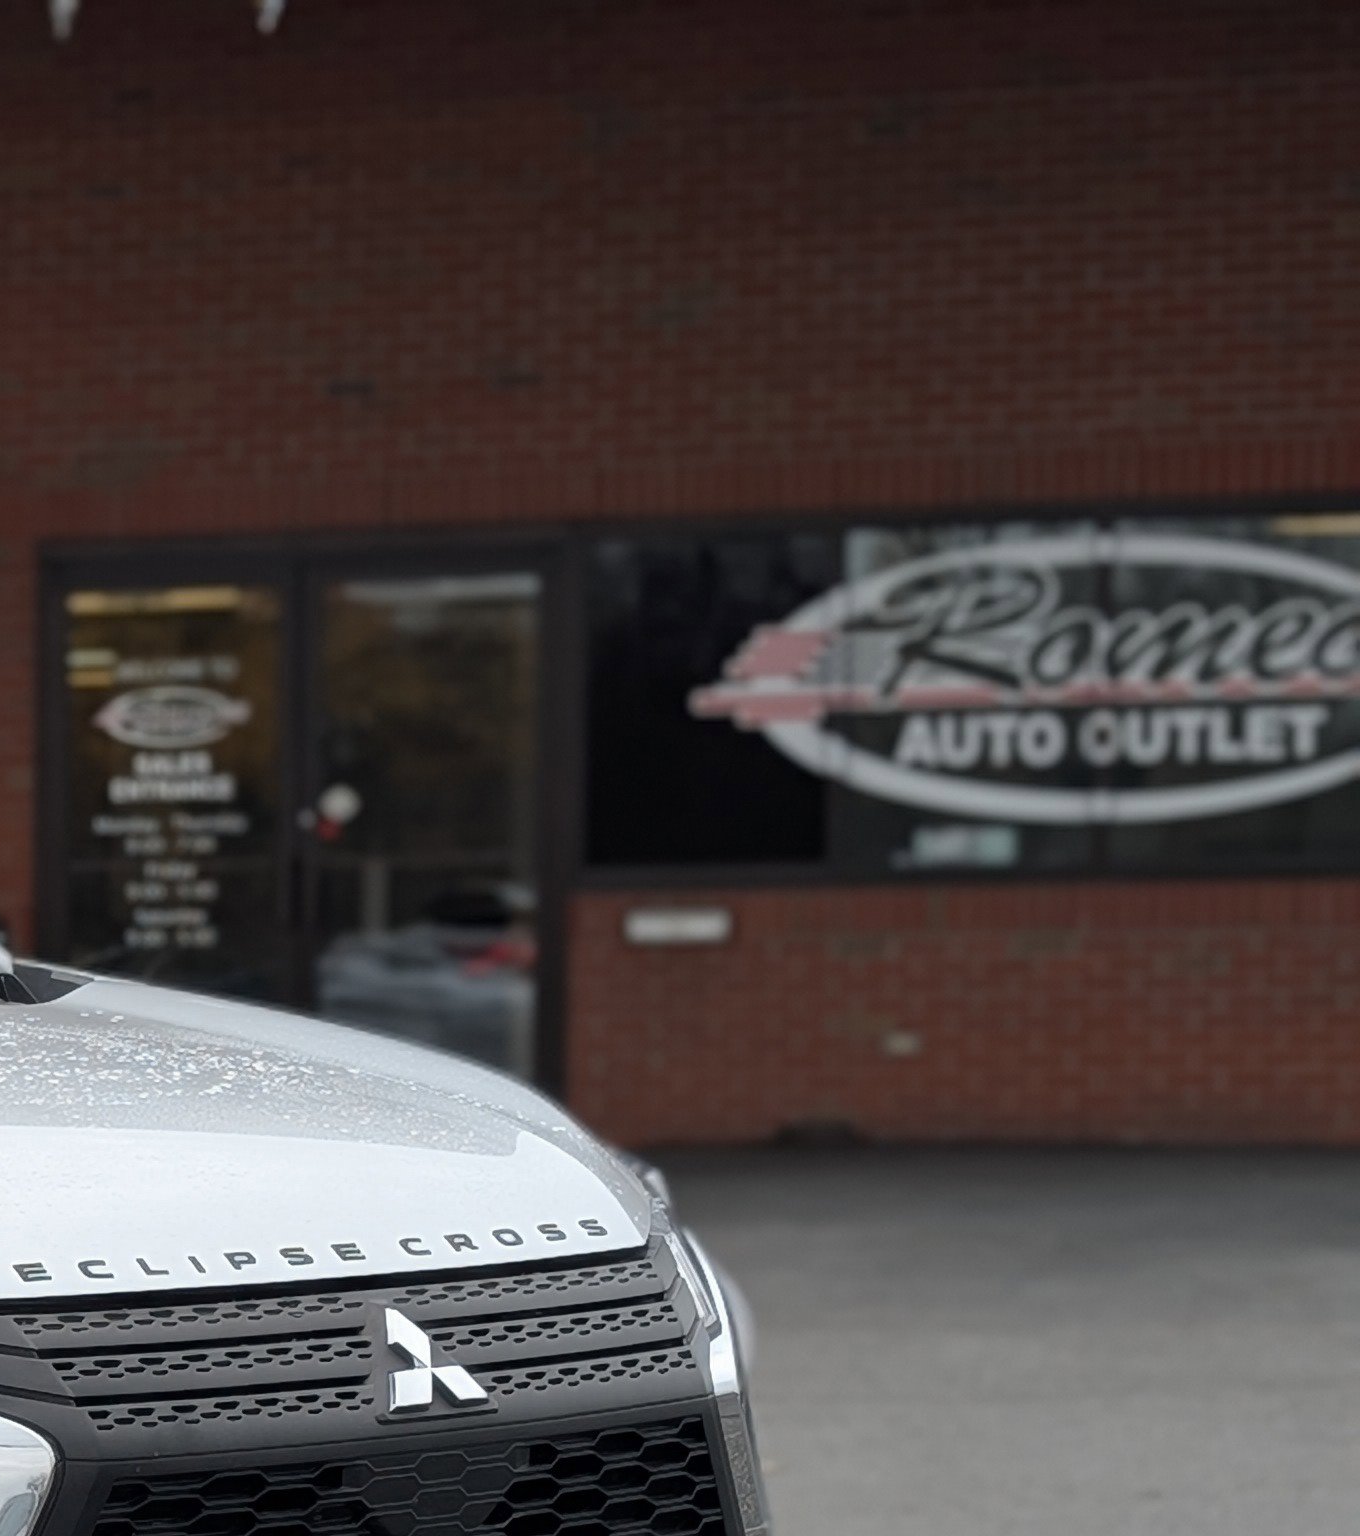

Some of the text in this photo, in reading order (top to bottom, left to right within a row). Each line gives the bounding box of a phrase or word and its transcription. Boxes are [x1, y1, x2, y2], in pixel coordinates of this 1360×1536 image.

[894, 704, 1327, 769] AUTO OUTLET
[11, 1217, 609, 1284] ECLIPSE CROSS
